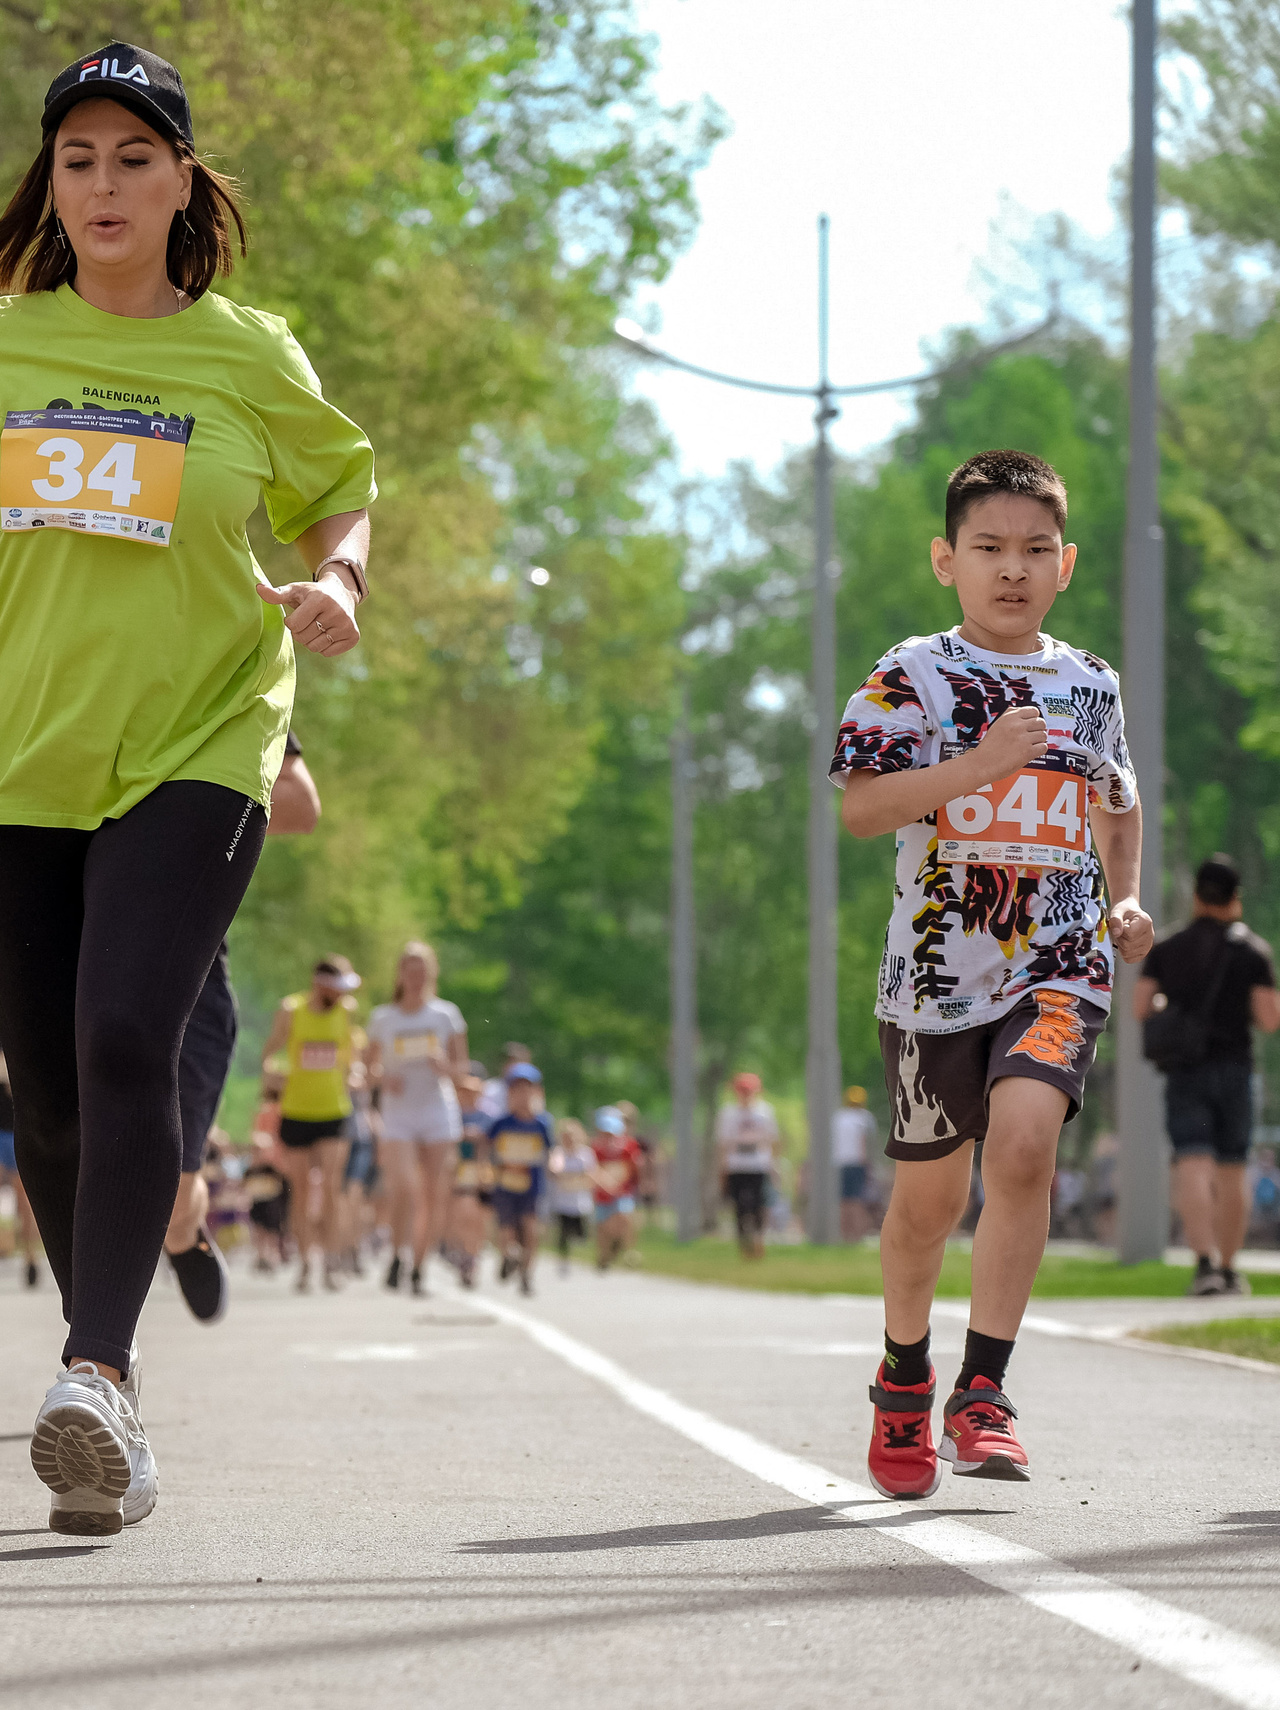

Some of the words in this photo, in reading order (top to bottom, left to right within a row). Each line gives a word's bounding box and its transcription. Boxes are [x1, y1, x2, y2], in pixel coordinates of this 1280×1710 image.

[79, 58, 150, 86] FILA
[81, 386, 161, 406] BALENCIAAA
[32, 437, 141, 507] 34
[946, 775, 1081, 843] 644
